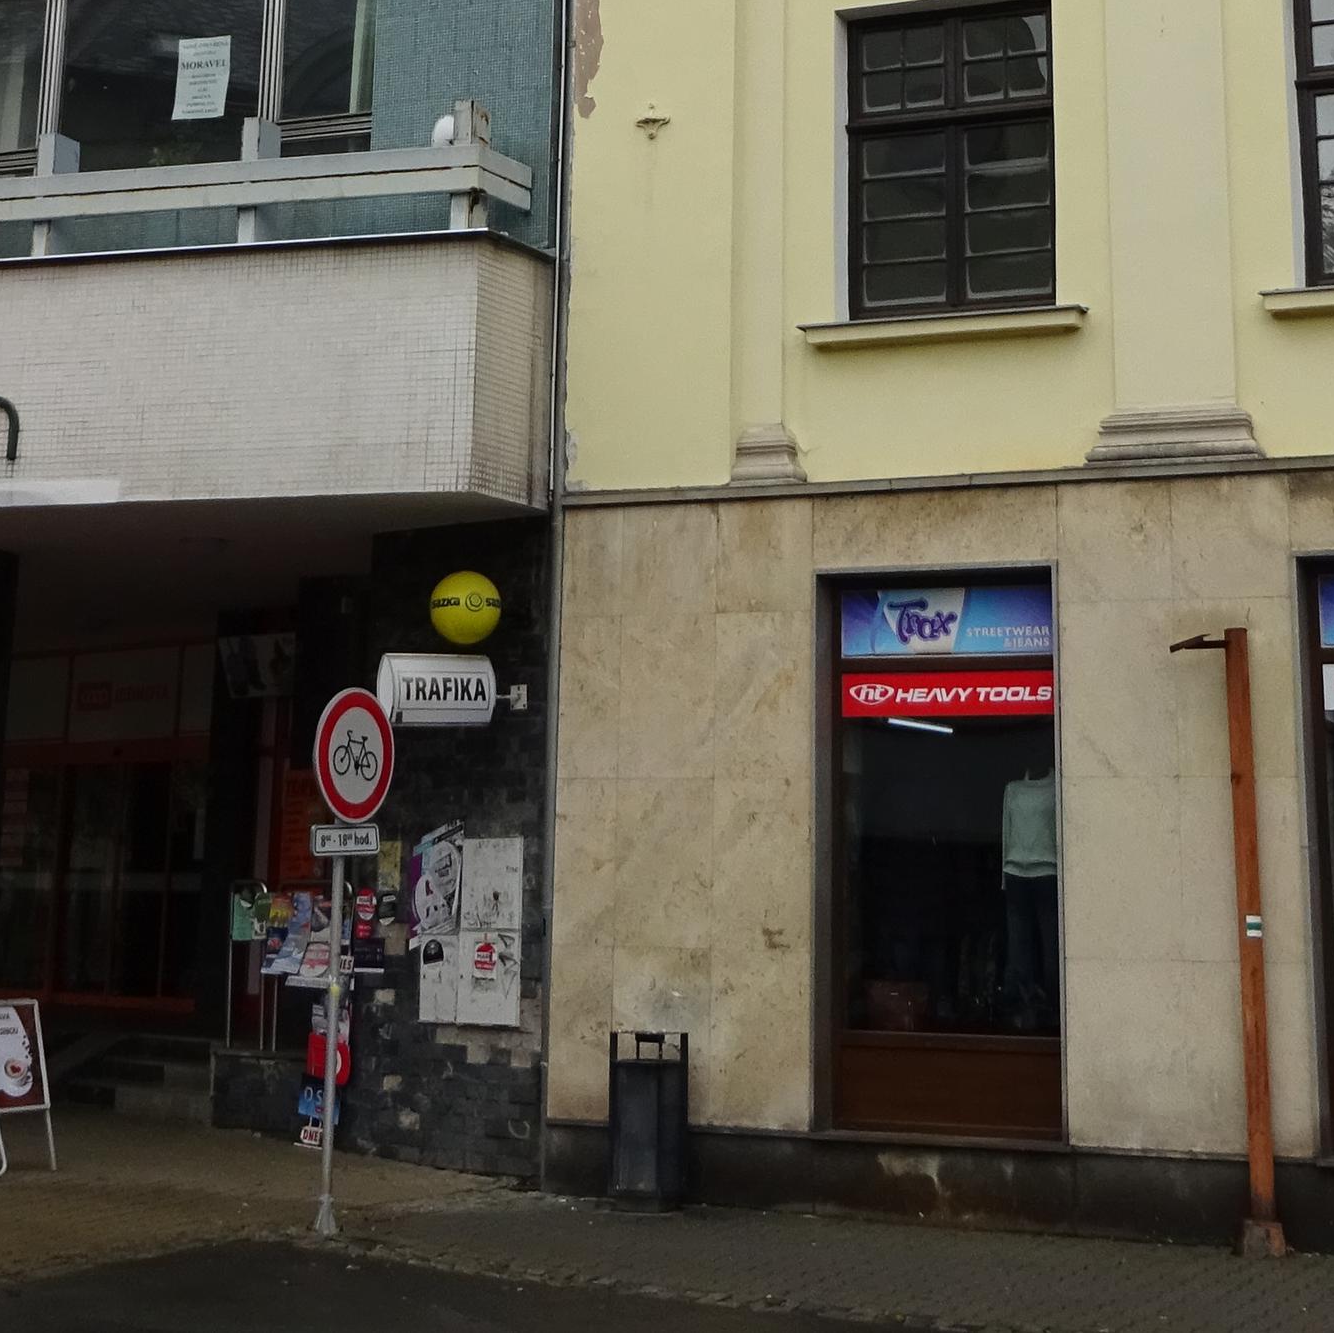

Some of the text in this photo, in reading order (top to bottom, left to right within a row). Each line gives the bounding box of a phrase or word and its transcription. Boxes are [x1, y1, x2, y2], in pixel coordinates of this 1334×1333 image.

[966, 626, 1051, 637] STREETWEAR
[402, 677, 487, 703] TRAFIKA
[895, 687, 974, 703] HEAVY
[976, 686, 1052, 702] TOOLS
[354, 832, 373, 846] hod.
